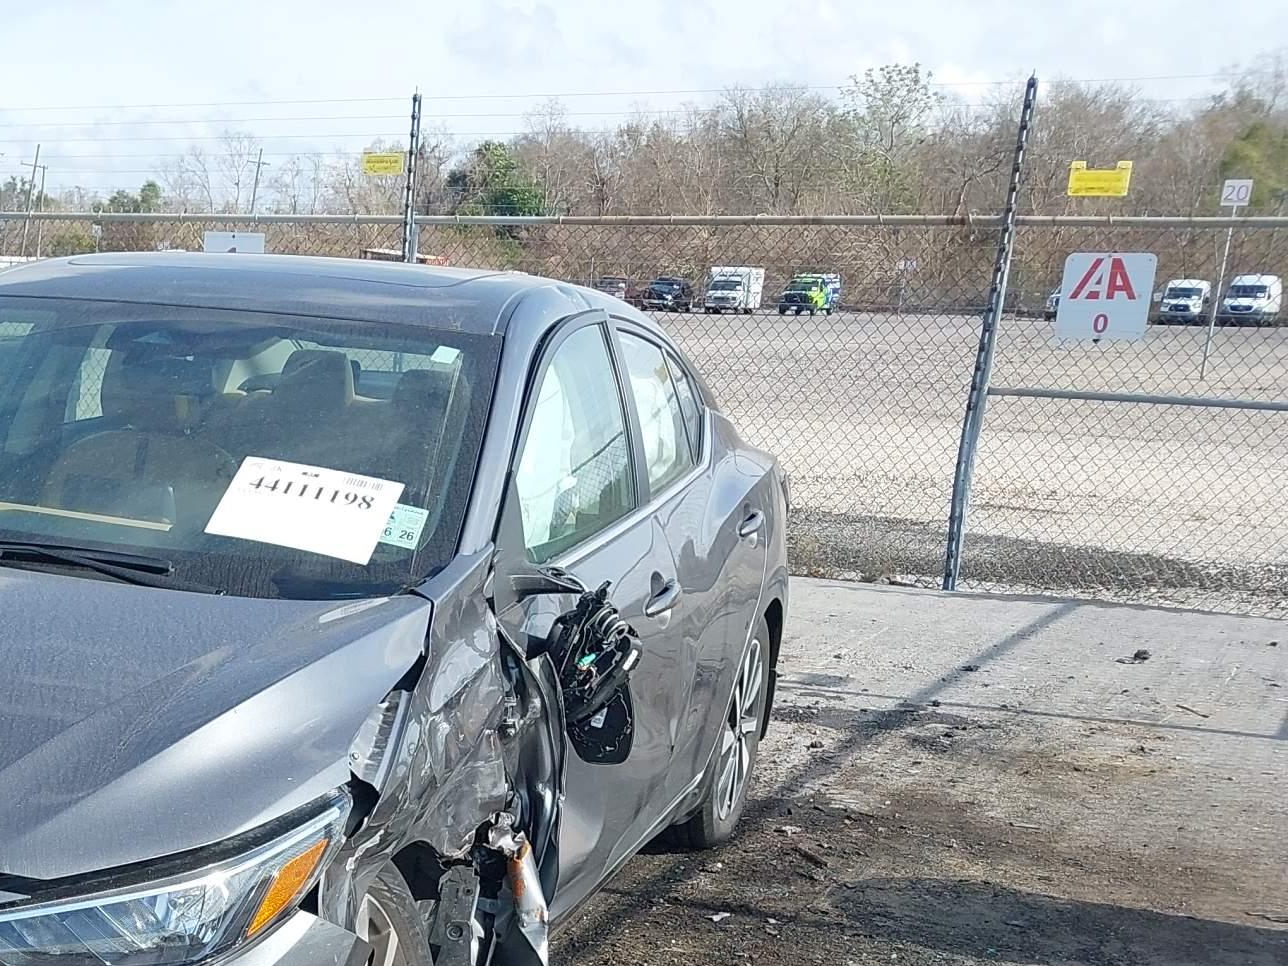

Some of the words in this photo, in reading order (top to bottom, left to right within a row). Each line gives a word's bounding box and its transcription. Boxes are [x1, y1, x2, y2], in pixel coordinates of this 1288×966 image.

[1224, 185, 1249, 200] 20
[249, 475, 376, 510] 44111198
[399, 529, 415, 541] 26
